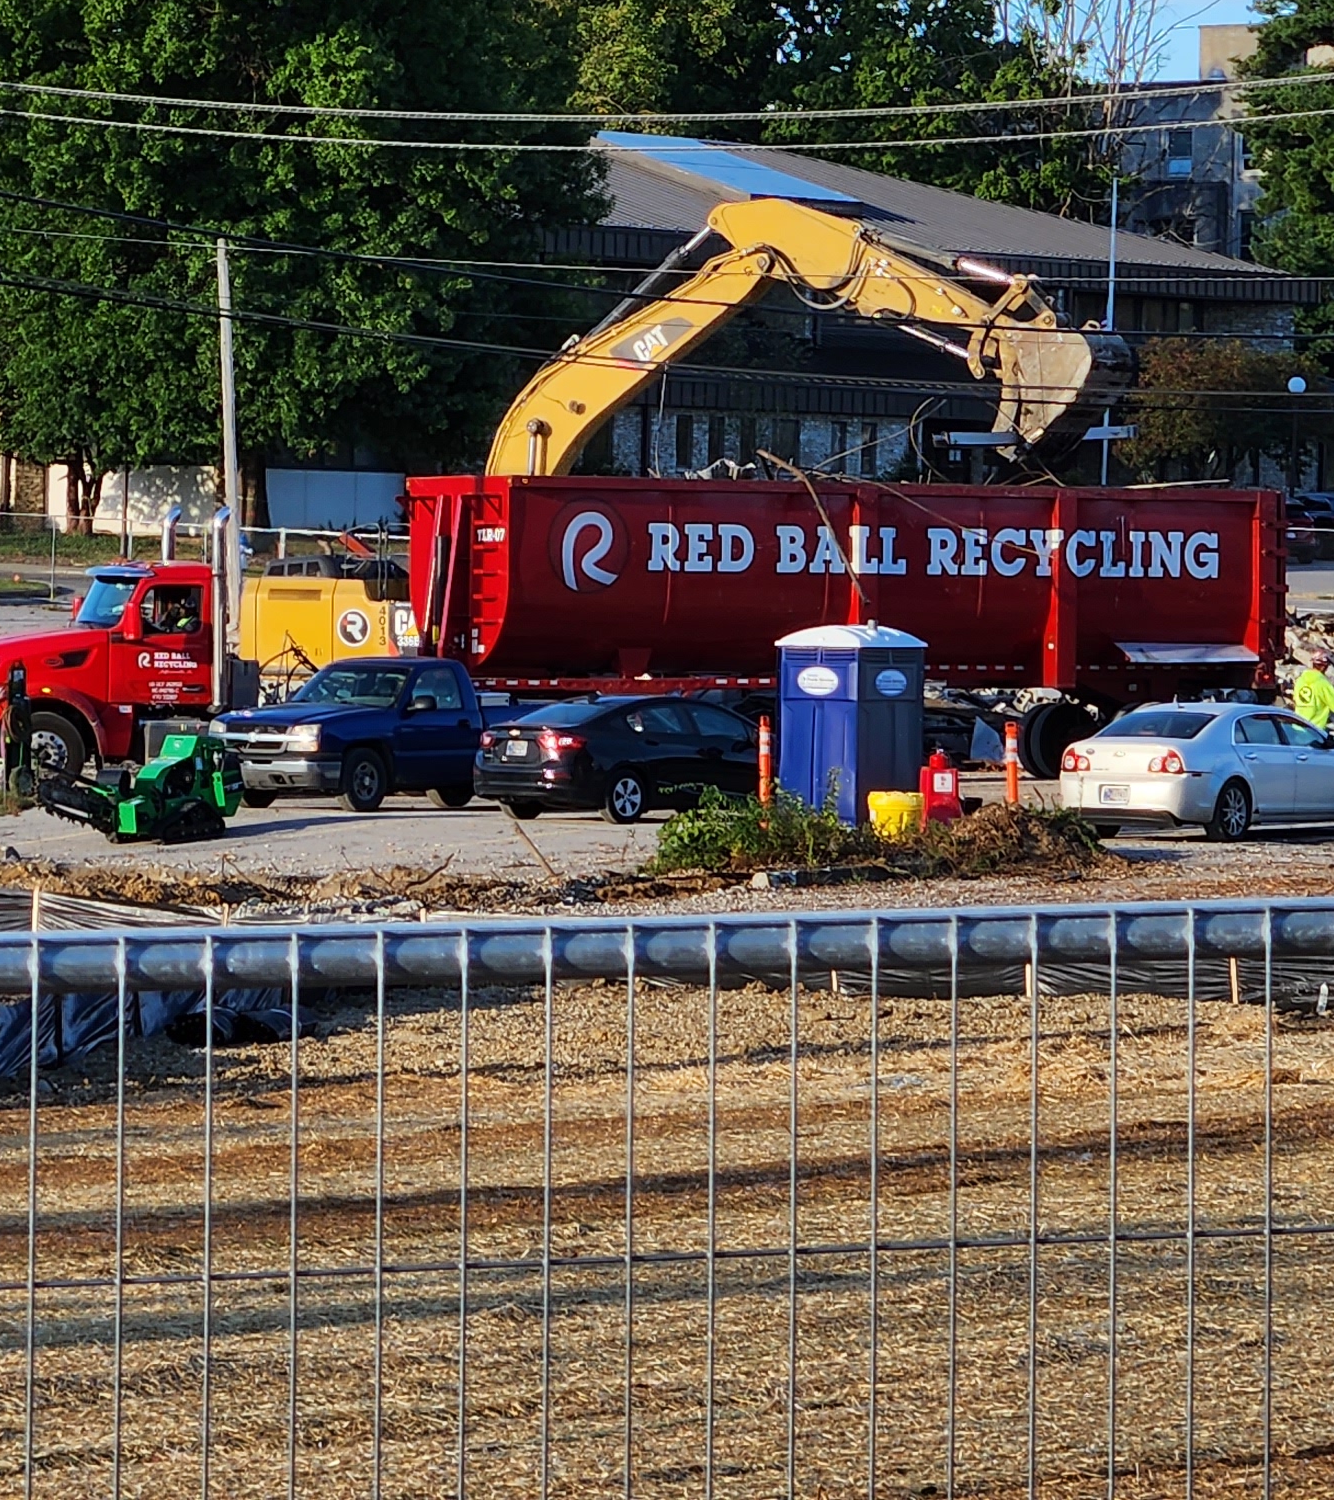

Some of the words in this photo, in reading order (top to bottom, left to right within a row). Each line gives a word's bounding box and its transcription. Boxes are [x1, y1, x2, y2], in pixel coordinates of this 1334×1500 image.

[632, 324, 669, 362] CAT
[562, 511, 618, 591] R
[647, 522, 755, 573] RED
[776, 524, 907, 575] BALL
[926, 527, 1219, 580] RECYCLING
